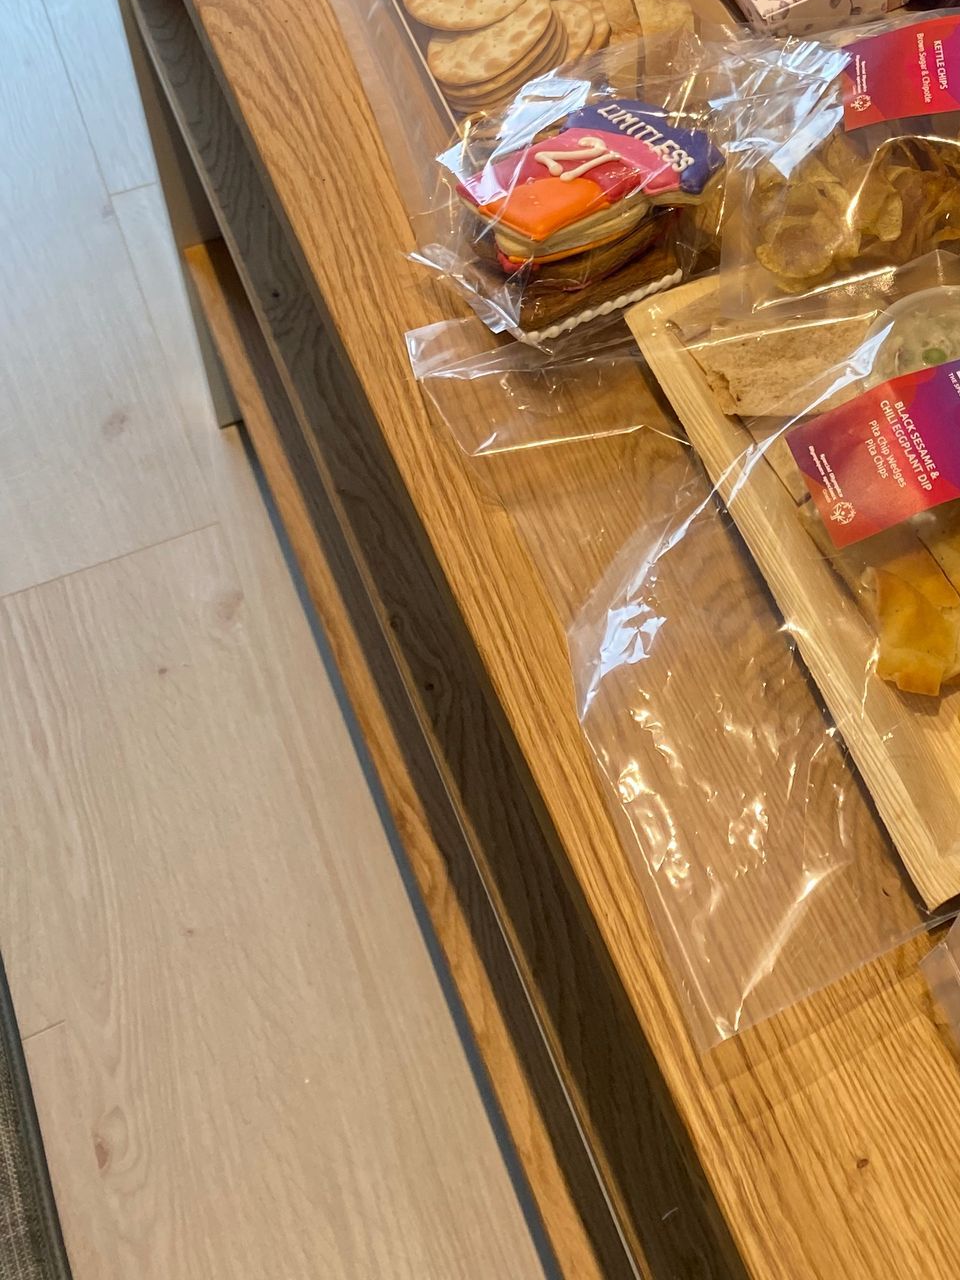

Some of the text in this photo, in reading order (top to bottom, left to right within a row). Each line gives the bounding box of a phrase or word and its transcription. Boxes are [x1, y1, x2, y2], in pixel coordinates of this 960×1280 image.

[918, 52, 927, 69] Sugar
[934, 40, 948, 89] KETTLE CHIPS
[922, 76, 932, 102] Chipotle
[597, 104, 695, 173] LIMITLESS
[948, 372, 957, 383] THE
[865, 439, 888, 478] Pita Chips
[869, 420, 906, 487] Pita Chip Wedges
[880, 400, 932, 490] CHILI EGGPLANT DIP
[894, 401, 939, 480] BLACK SESAME &
